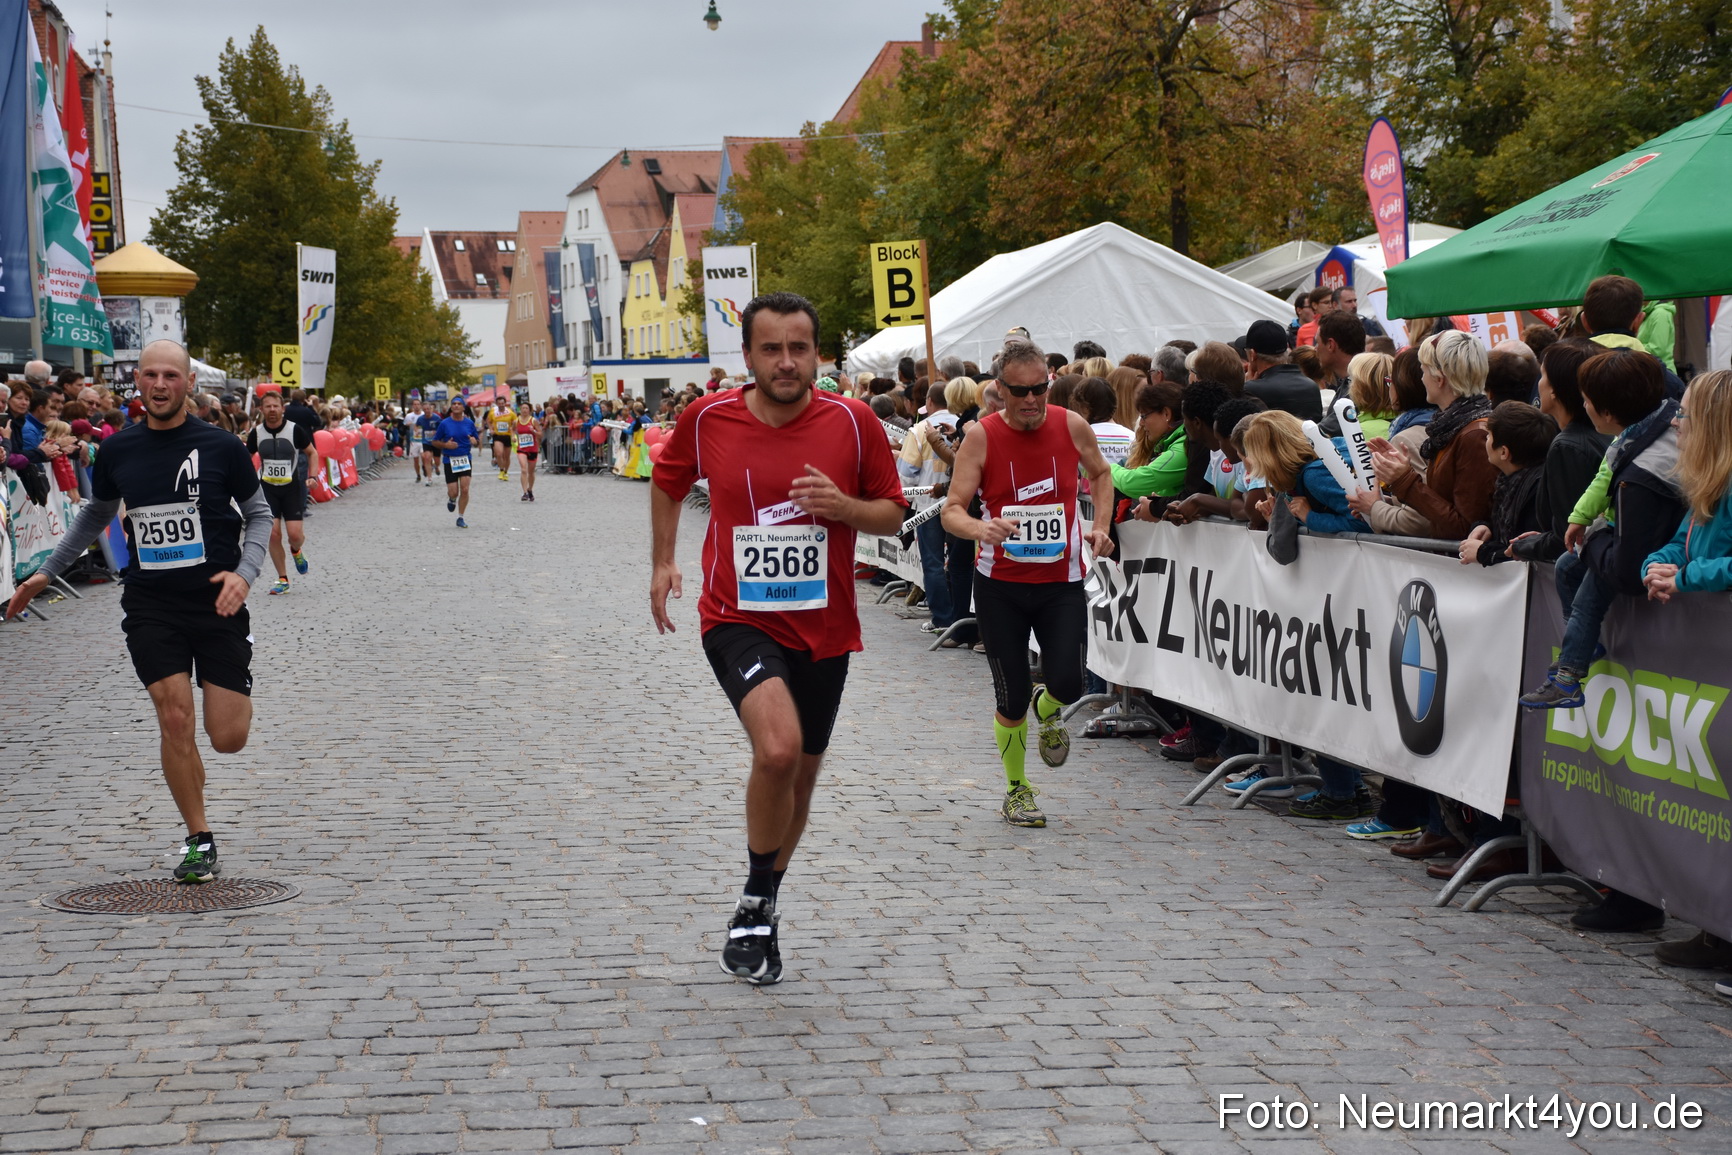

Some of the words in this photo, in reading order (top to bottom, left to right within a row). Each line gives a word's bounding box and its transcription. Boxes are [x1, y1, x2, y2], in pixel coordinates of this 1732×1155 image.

[877, 244, 920, 262] Block
[49, 278, 80, 289] ervice
[887, 267, 916, 309] B
[52, 308, 110, 332] ice-Line
[275, 345, 298, 355] Block
[279, 357, 293, 377] C
[379, 384, 387, 396] D
[596, 379, 604, 390] D
[268, 466, 286, 476] 360
[1027, 484, 1045, 495] DEHN
[150, 509, 185, 518] Neumarkt
[772, 505, 795, 519] DEHN
[906, 514, 926, 531] BMW
[138, 517, 196, 545] 2599
[735, 534, 766, 542] PARTL
[767, 534, 812, 542] Neumarkt
[153, 549, 184, 561] Tobias
[1023, 546, 1046, 555] Peter
[743, 545, 819, 578] 2568
[765, 585, 797, 599] Adolf
[1189, 565, 1372, 712] Neumarkt
[1542, 750, 1601, 794] inspired
[1615, 784, 1656, 818] smart
[1658, 798, 1732, 844] concepts
